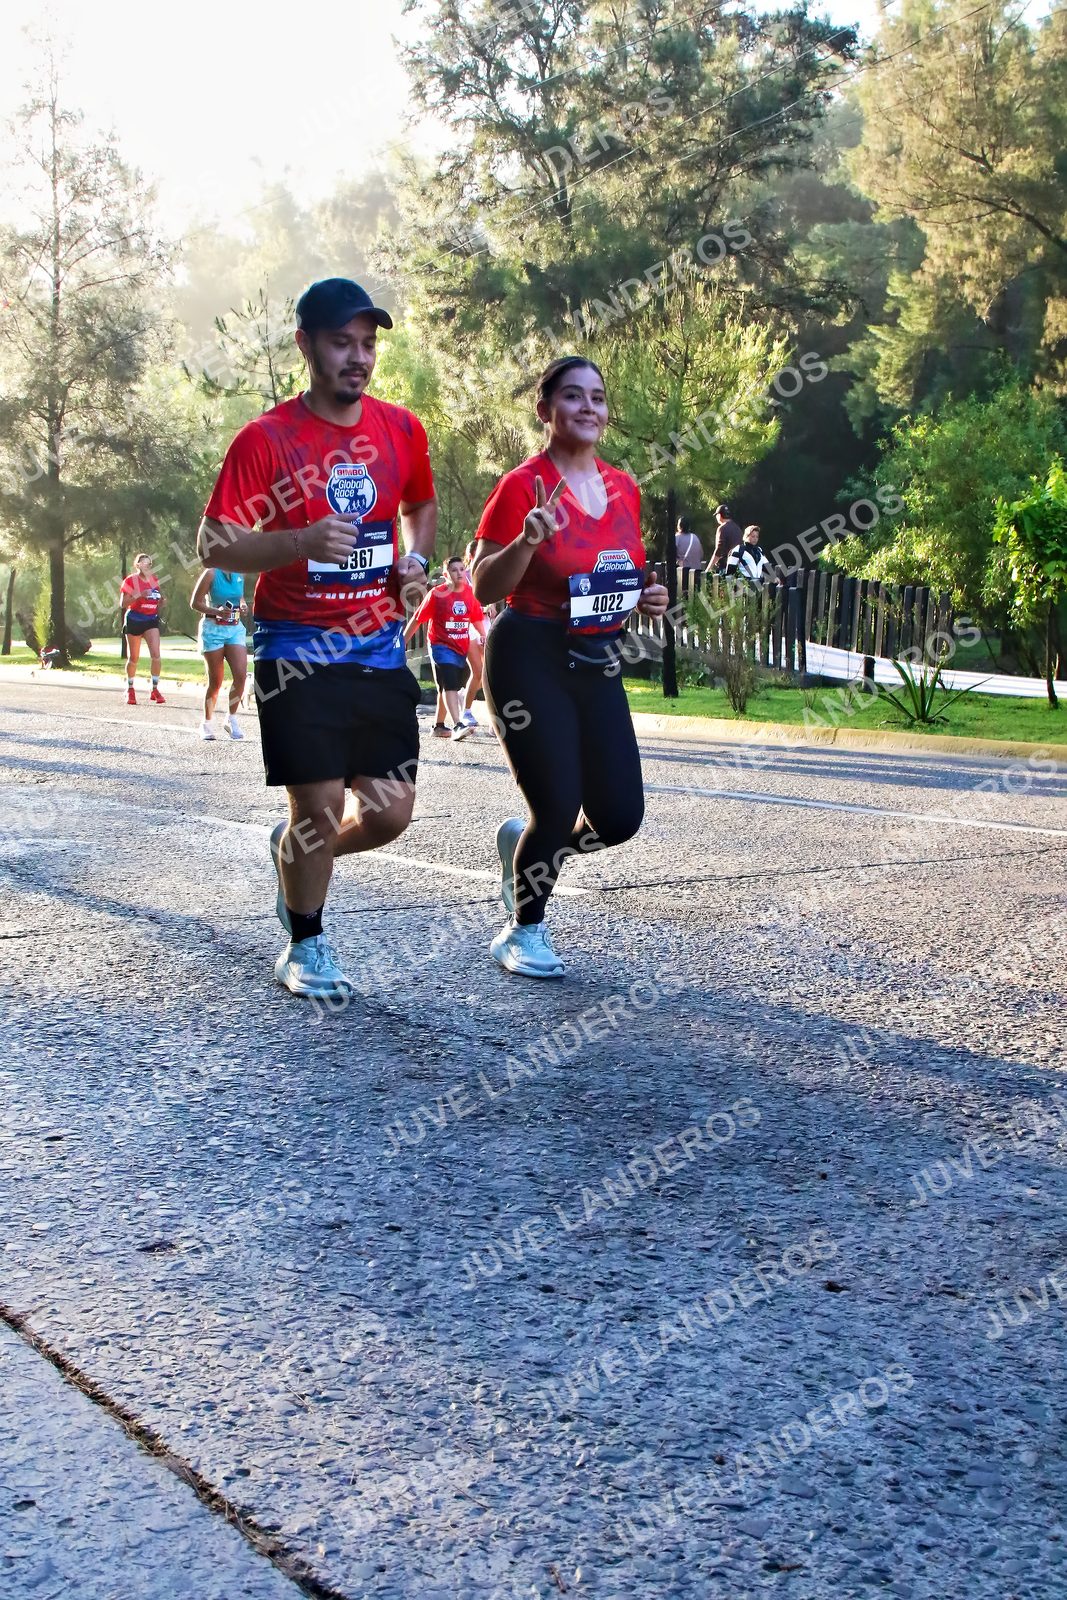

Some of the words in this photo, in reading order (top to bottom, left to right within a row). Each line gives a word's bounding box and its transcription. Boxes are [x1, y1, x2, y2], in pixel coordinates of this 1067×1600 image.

[337, 468, 363, 476] BIMBO
[338, 479, 364, 489] Global
[334, 488, 355, 498] Race
[604, 562, 627, 571] Global
[592, 593, 623, 613] 4022
